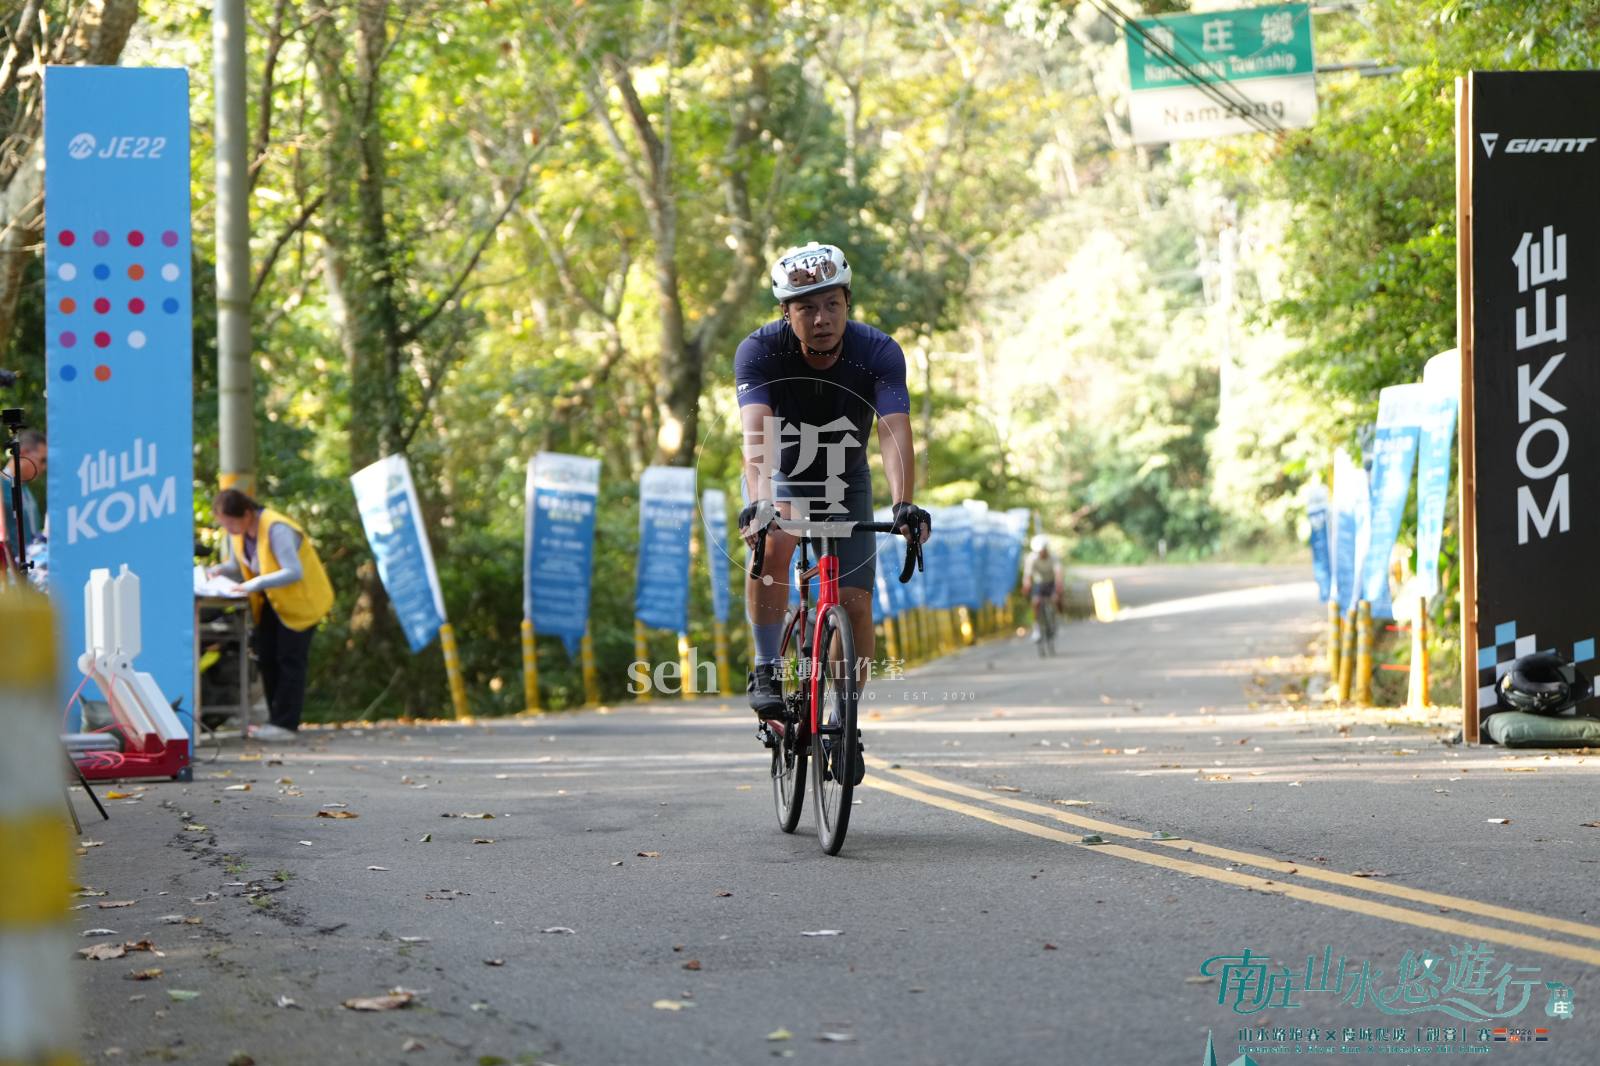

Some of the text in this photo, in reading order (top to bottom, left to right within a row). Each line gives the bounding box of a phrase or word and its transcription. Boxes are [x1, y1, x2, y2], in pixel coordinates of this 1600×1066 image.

[1229, 53, 1296, 74] Township
[99, 136, 167, 158] JE22
[1505, 137, 1597, 153] GIANT
[77, 437, 157, 497] 仙山
[67, 476, 177, 545] KOM
